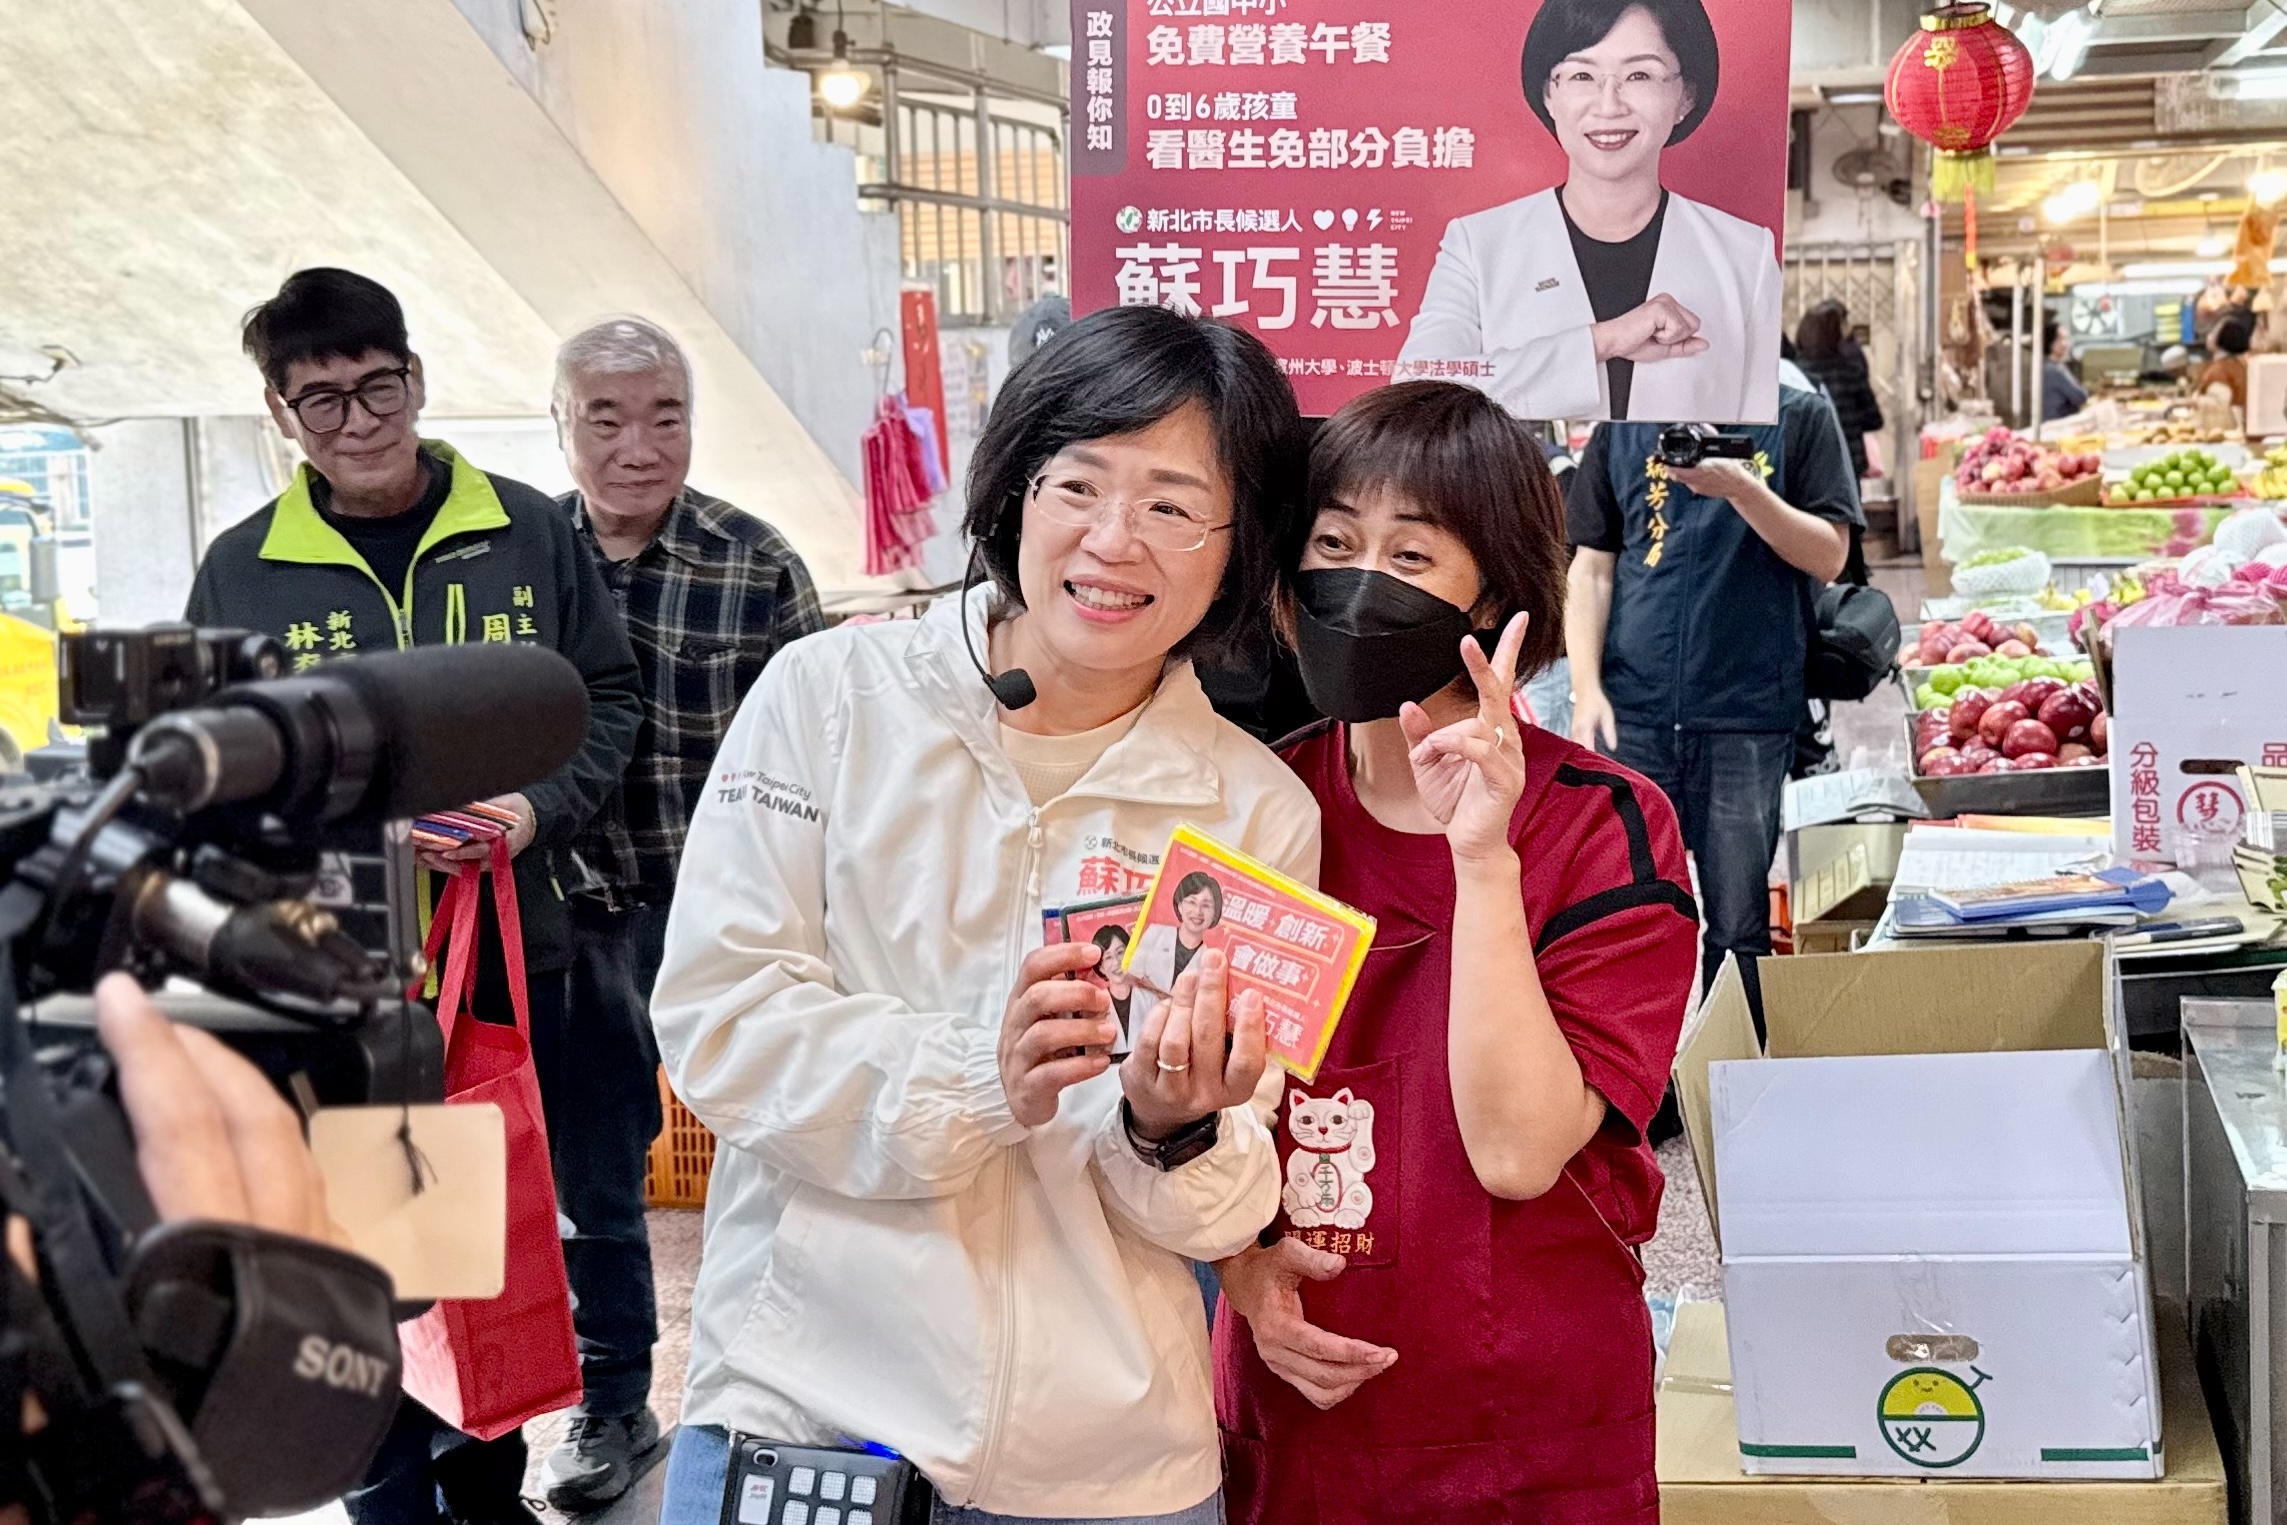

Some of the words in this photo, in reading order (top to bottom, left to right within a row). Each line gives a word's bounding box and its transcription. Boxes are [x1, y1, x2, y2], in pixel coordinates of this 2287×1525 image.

[1146, 22, 1391, 66] 免費營養午餐
[1086, 11, 1113, 151] 政見報你知
[1146, 91, 1298, 121] 0到6歲孩童
[1146, 127, 1475, 170] 看醫生免部分負擔
[1147, 208, 1303, 233] 新北市長候選人
[1115, 242, 1401, 330] 蘇巧慧
[1644, 455, 1669, 567] 瑞芳分局
[326, 609, 357, 660] 新北
[482, 613, 511, 644] 周
[513, 585, 538, 646] 副主
[752, 785, 819, 823] TAIWAN
[756, 770, 789, 791] Taipei
[788, 783, 812, 801] City
[2130, 741, 2161, 852] 分級包裝
[1274, 913, 1329, 951] 創新
[1231, 944, 1306, 986] 會做事
[293, 1333, 389, 1397] SONY
